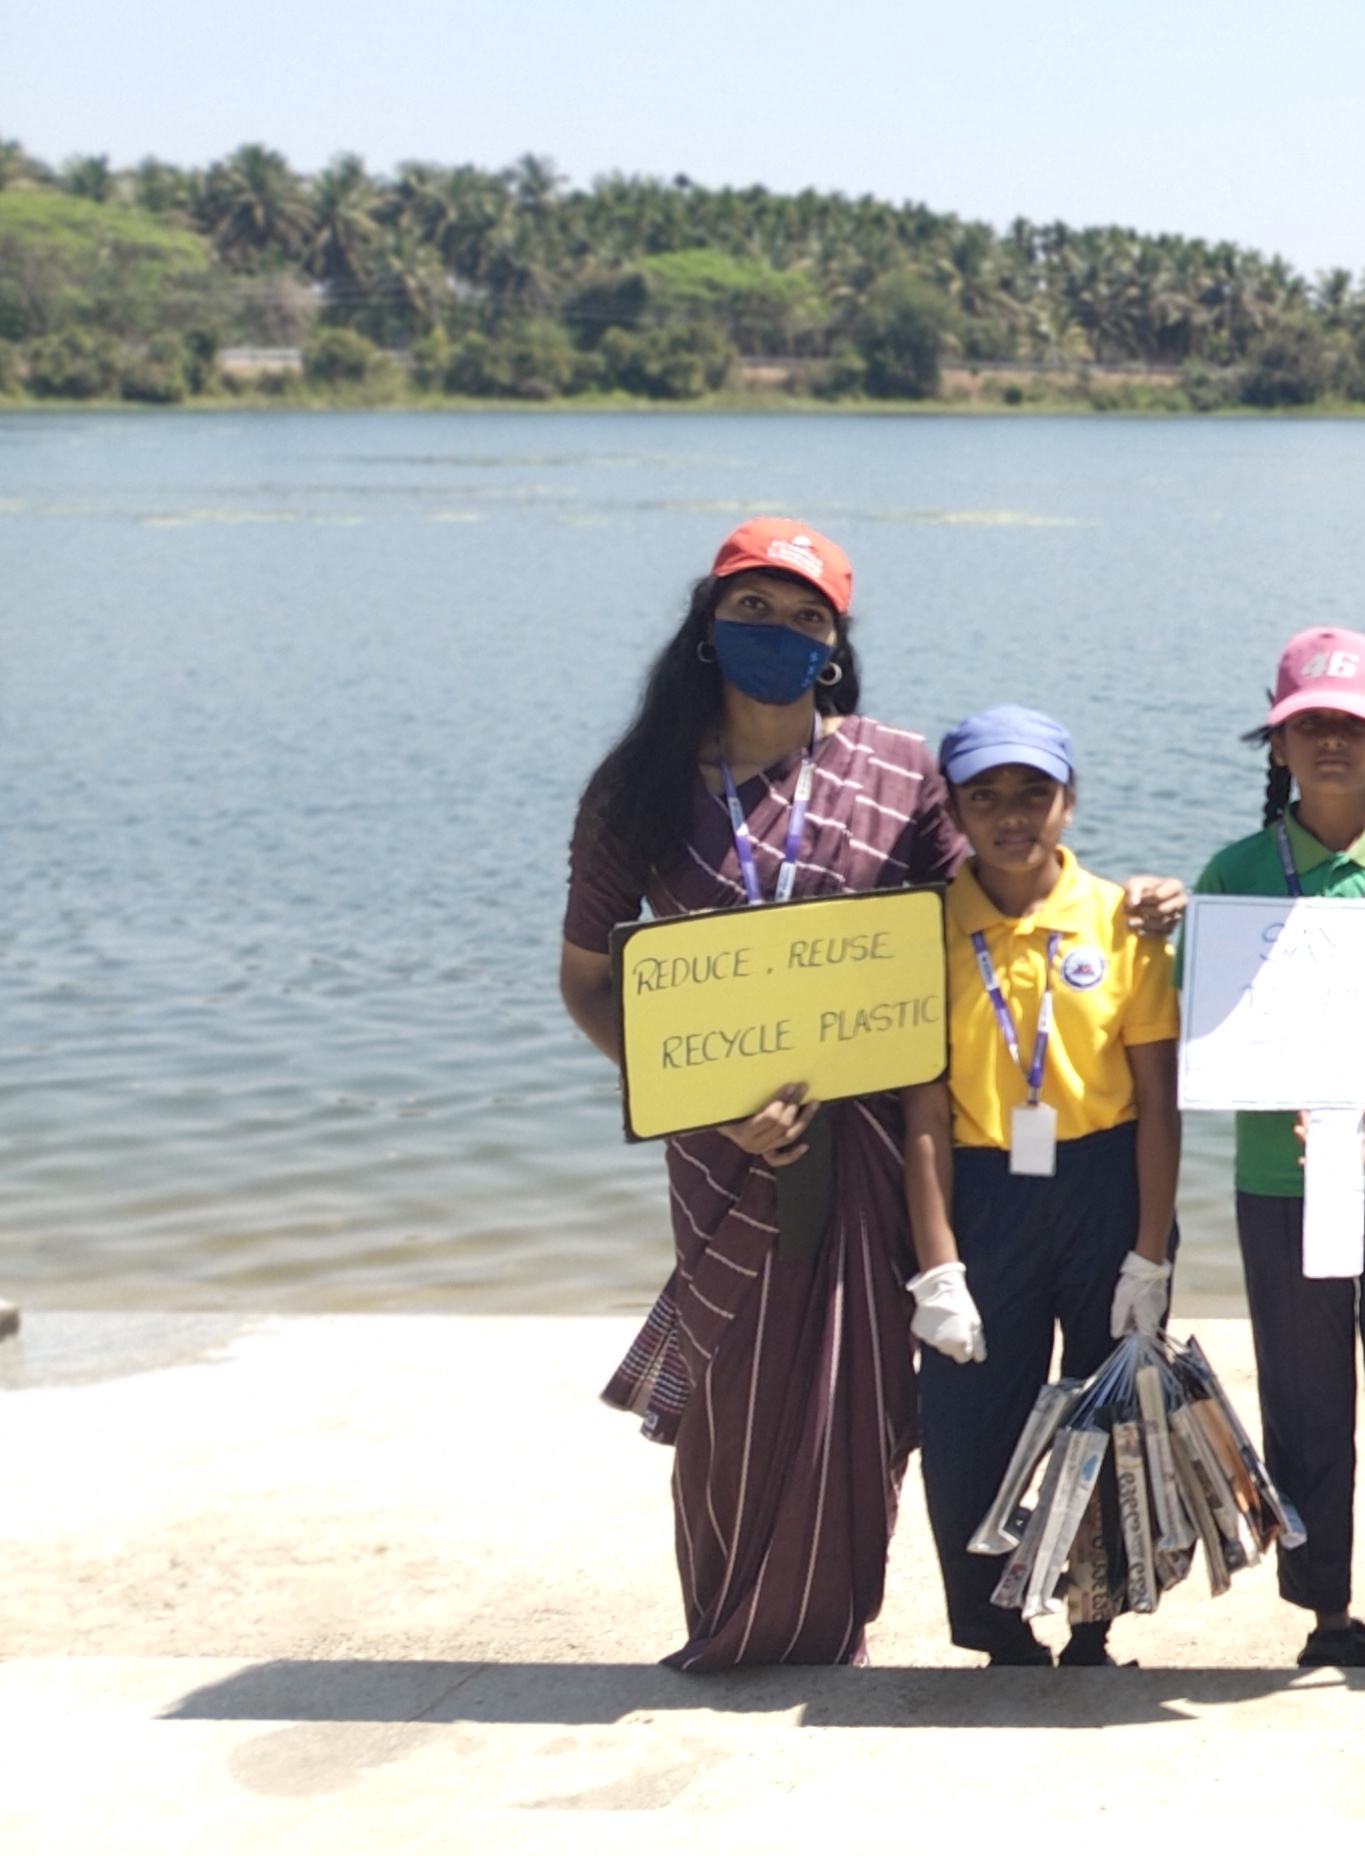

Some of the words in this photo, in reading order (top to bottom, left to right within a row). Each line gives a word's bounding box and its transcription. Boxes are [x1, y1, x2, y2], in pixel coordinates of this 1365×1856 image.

[1299, 649, 1360, 679] 46
[787, 931, 896, 969] REUSE
[661, 1019, 797, 1070] RECYCLE
[818, 994, 940, 1043] PLASTIC
